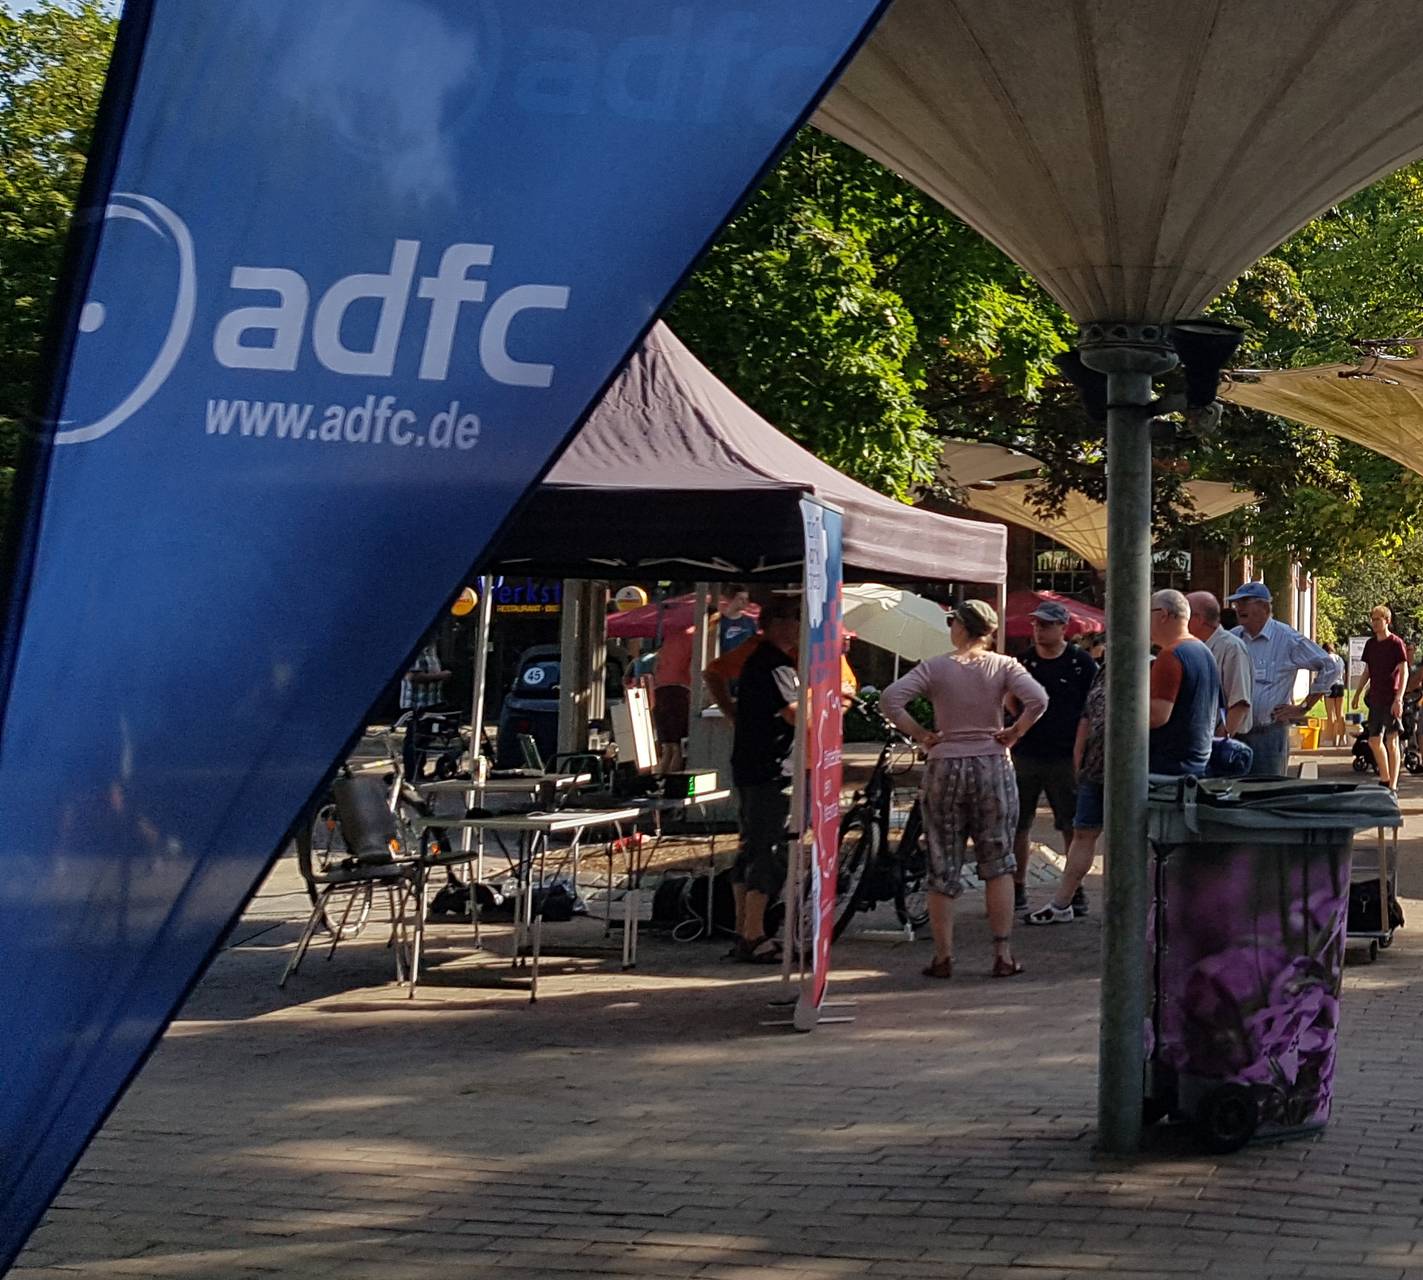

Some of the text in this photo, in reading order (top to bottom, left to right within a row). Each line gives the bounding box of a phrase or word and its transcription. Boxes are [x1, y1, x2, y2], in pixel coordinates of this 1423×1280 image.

[213, 239, 571, 388] adfc
[205, 395, 480, 450] www.adfc.de
[527, 670, 541, 681] 45
